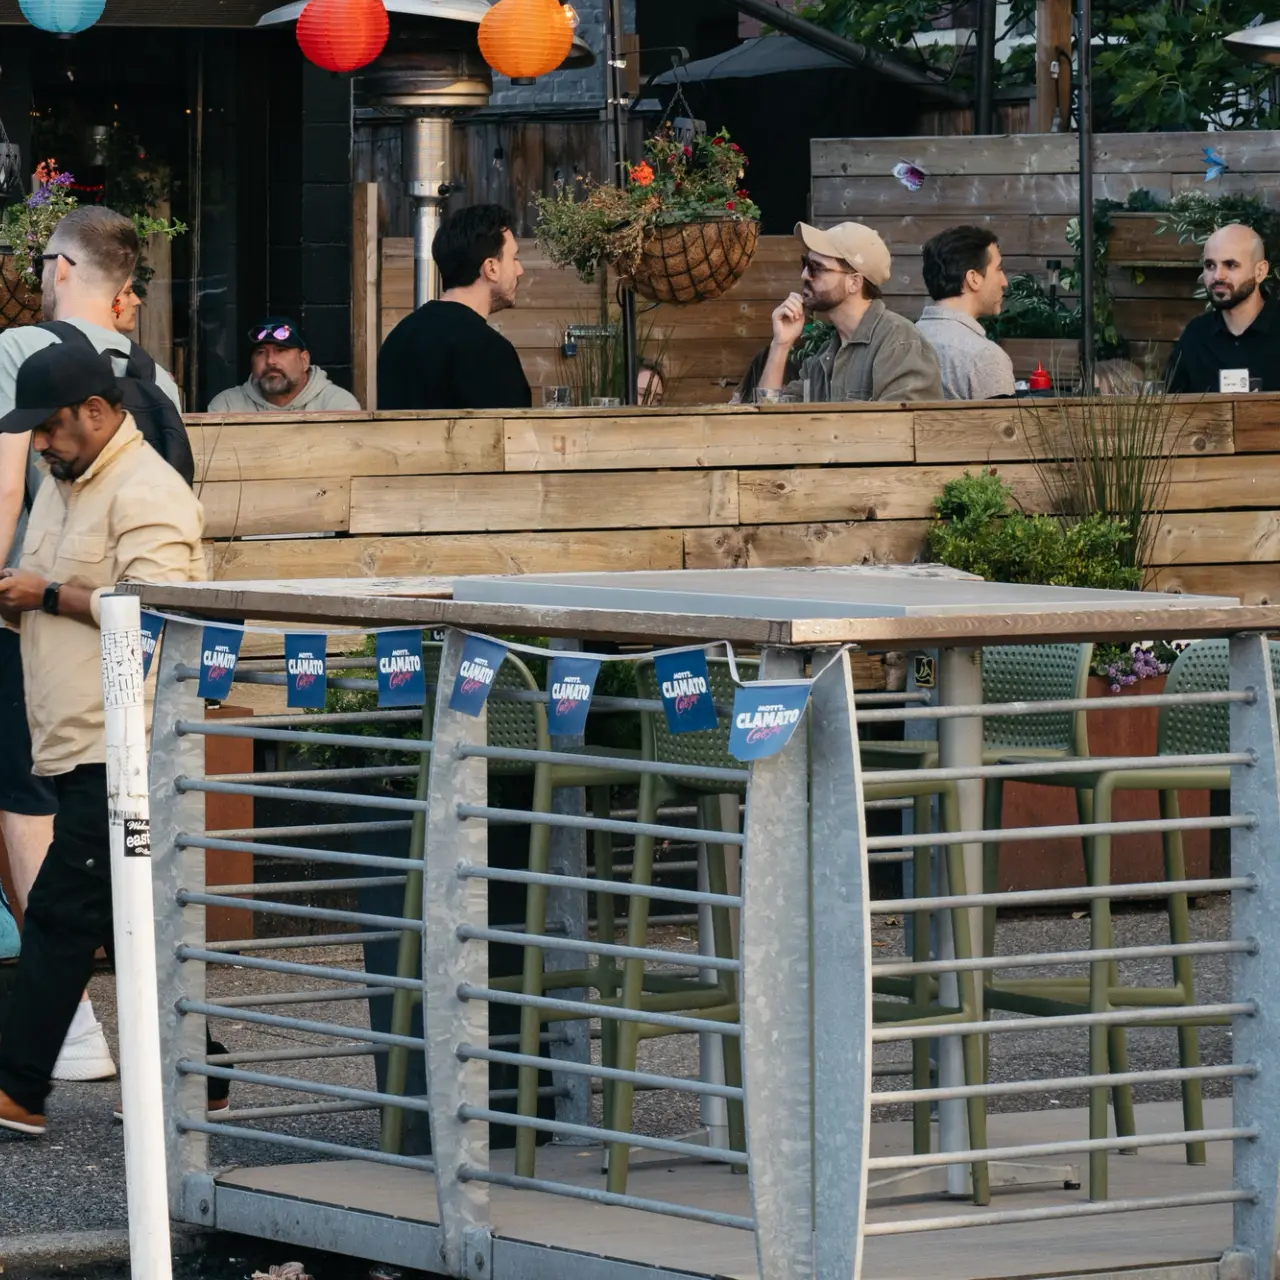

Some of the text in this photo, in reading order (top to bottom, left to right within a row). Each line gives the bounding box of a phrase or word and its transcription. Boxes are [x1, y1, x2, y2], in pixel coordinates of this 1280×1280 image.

[203, 650, 237, 670] CLAMATO
[288, 658, 324, 675] CLAMATO
[379, 655, 421, 674] CLAMATO
[460, 660, 494, 684] CLAMATO
[551, 682, 591, 701] CLAMATO
[662, 676, 708, 699] CLAMATO
[736, 708, 801, 729] CLAMATO
